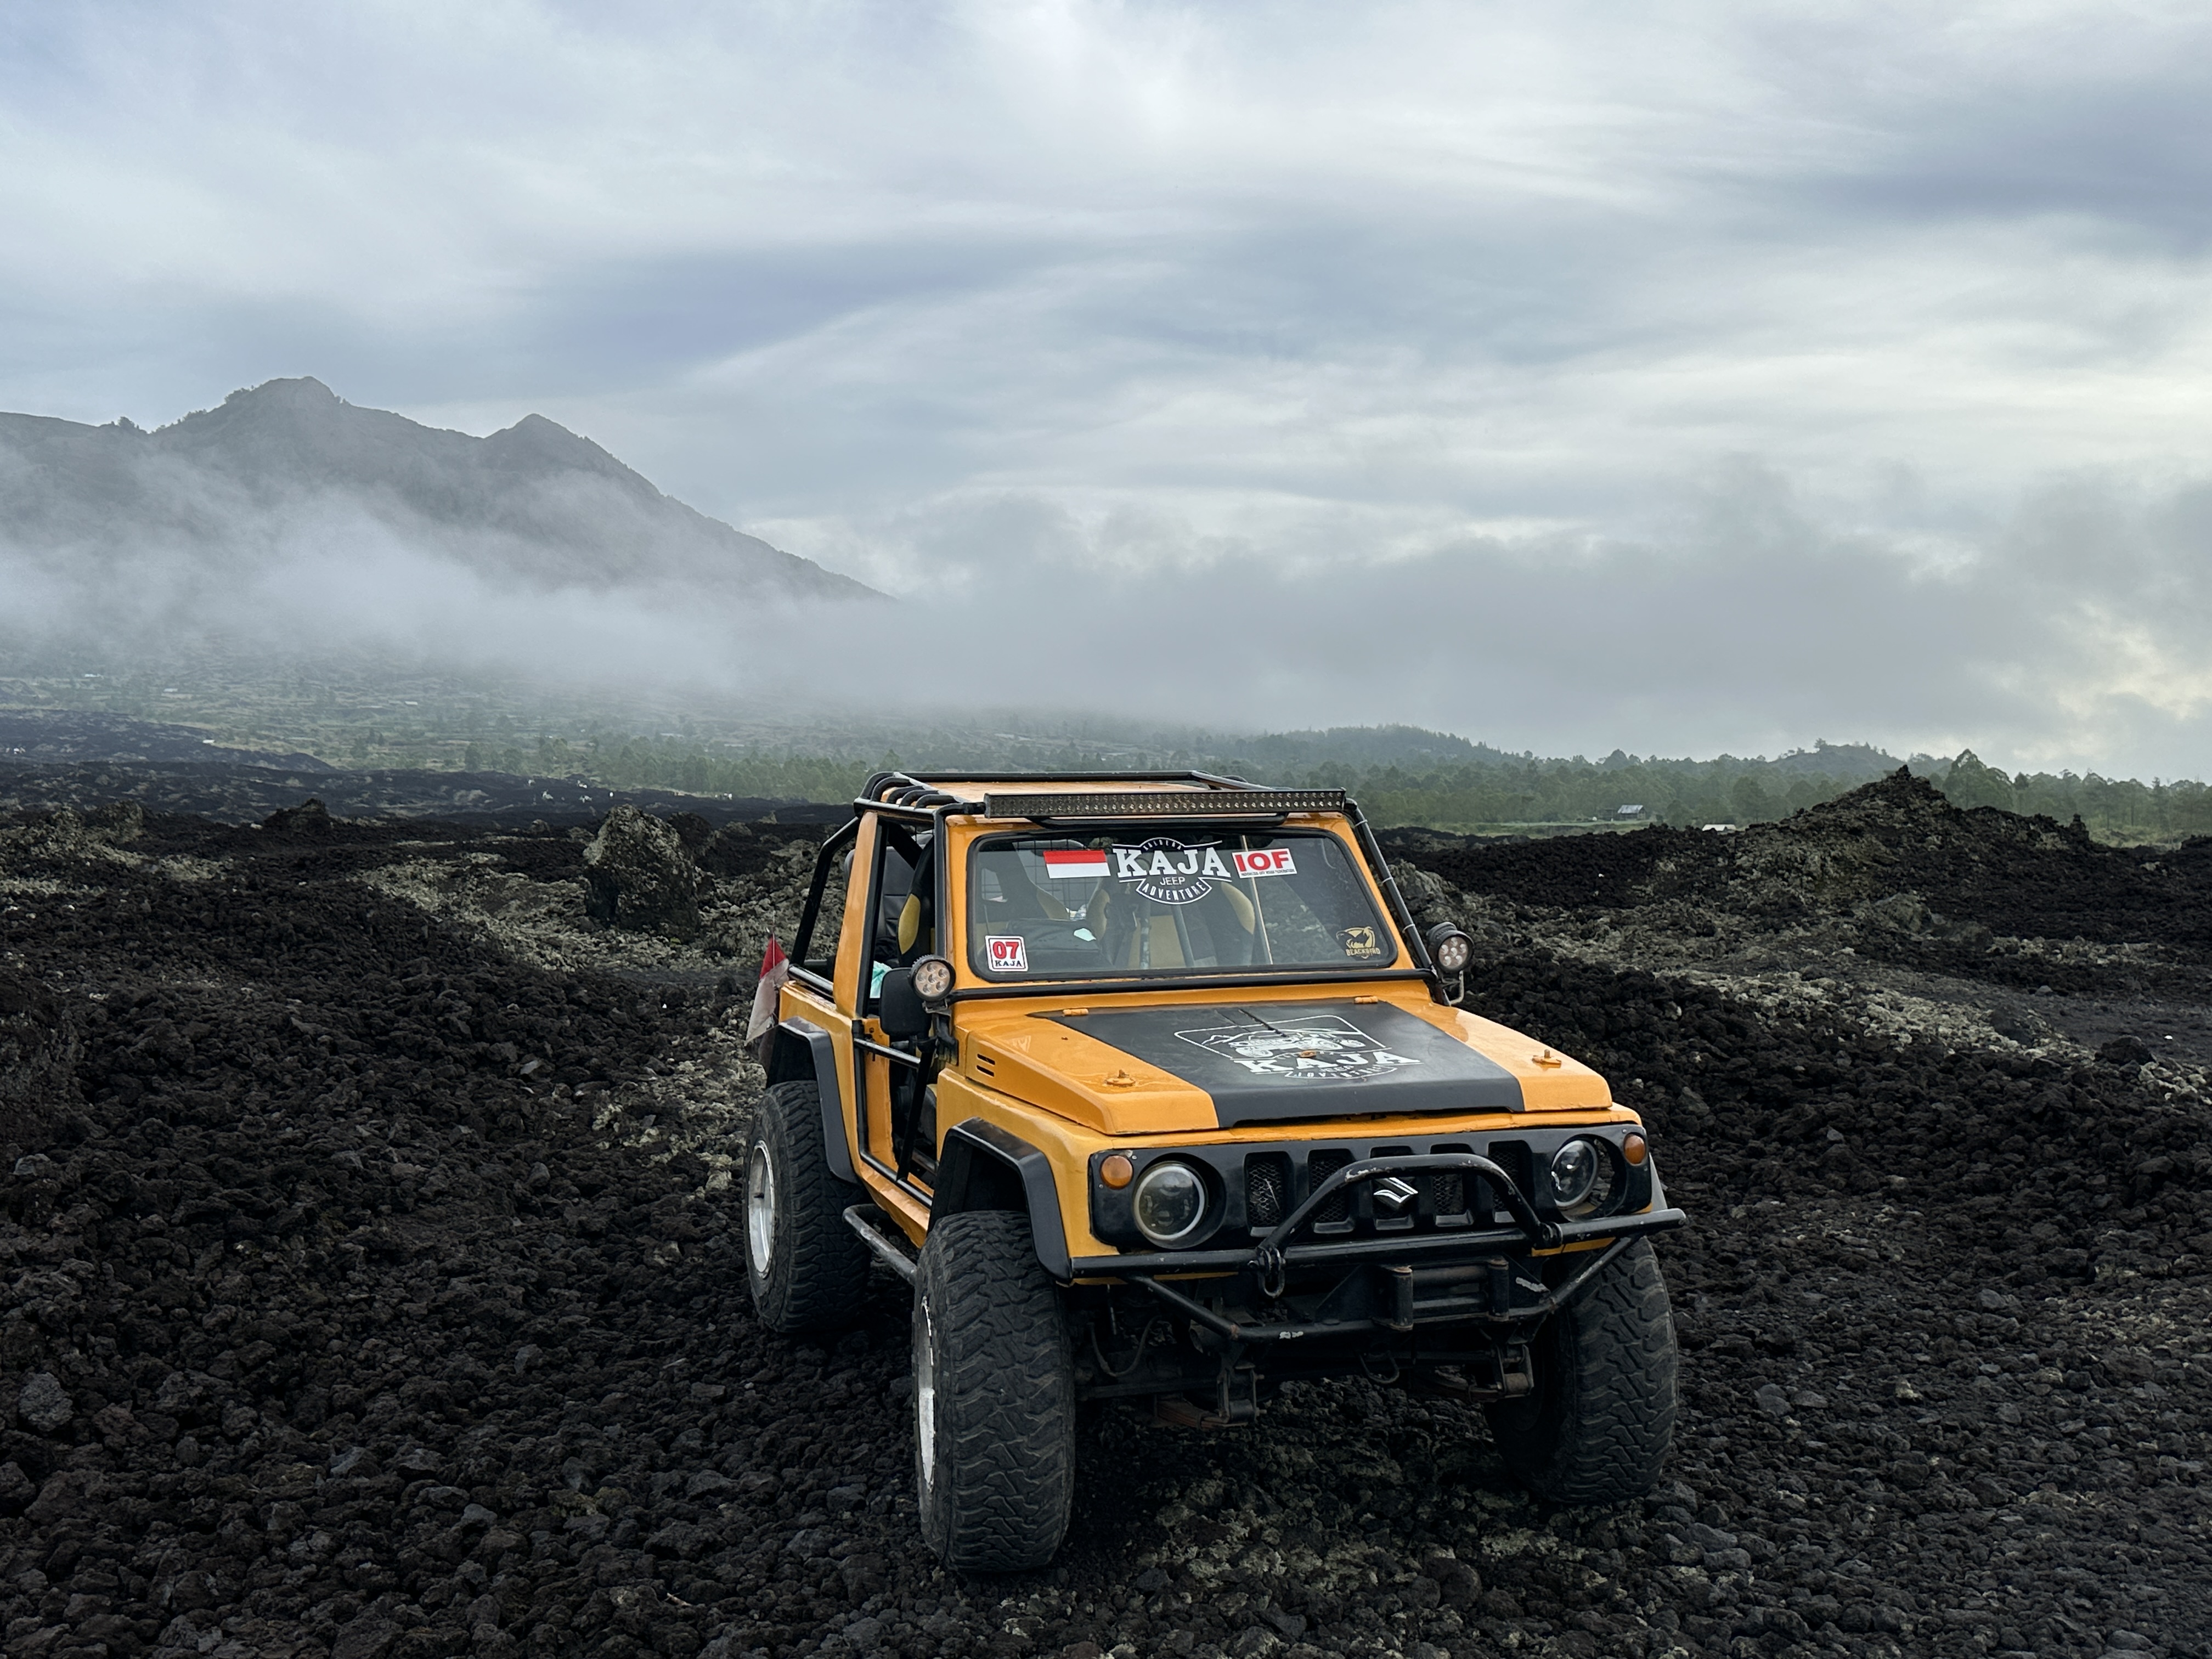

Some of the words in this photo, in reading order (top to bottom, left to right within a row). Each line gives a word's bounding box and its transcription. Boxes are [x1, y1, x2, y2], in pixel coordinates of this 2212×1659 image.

[1113, 847, 1231, 878] KAJA
[1234, 851, 1289, 871] IOF
[1160, 876, 1185, 885] JEEP
[1142, 881, 1206, 901] ADVENTURE
[992, 941, 1019, 959] 07
[1233, 1051, 1421, 1073] KAJA
